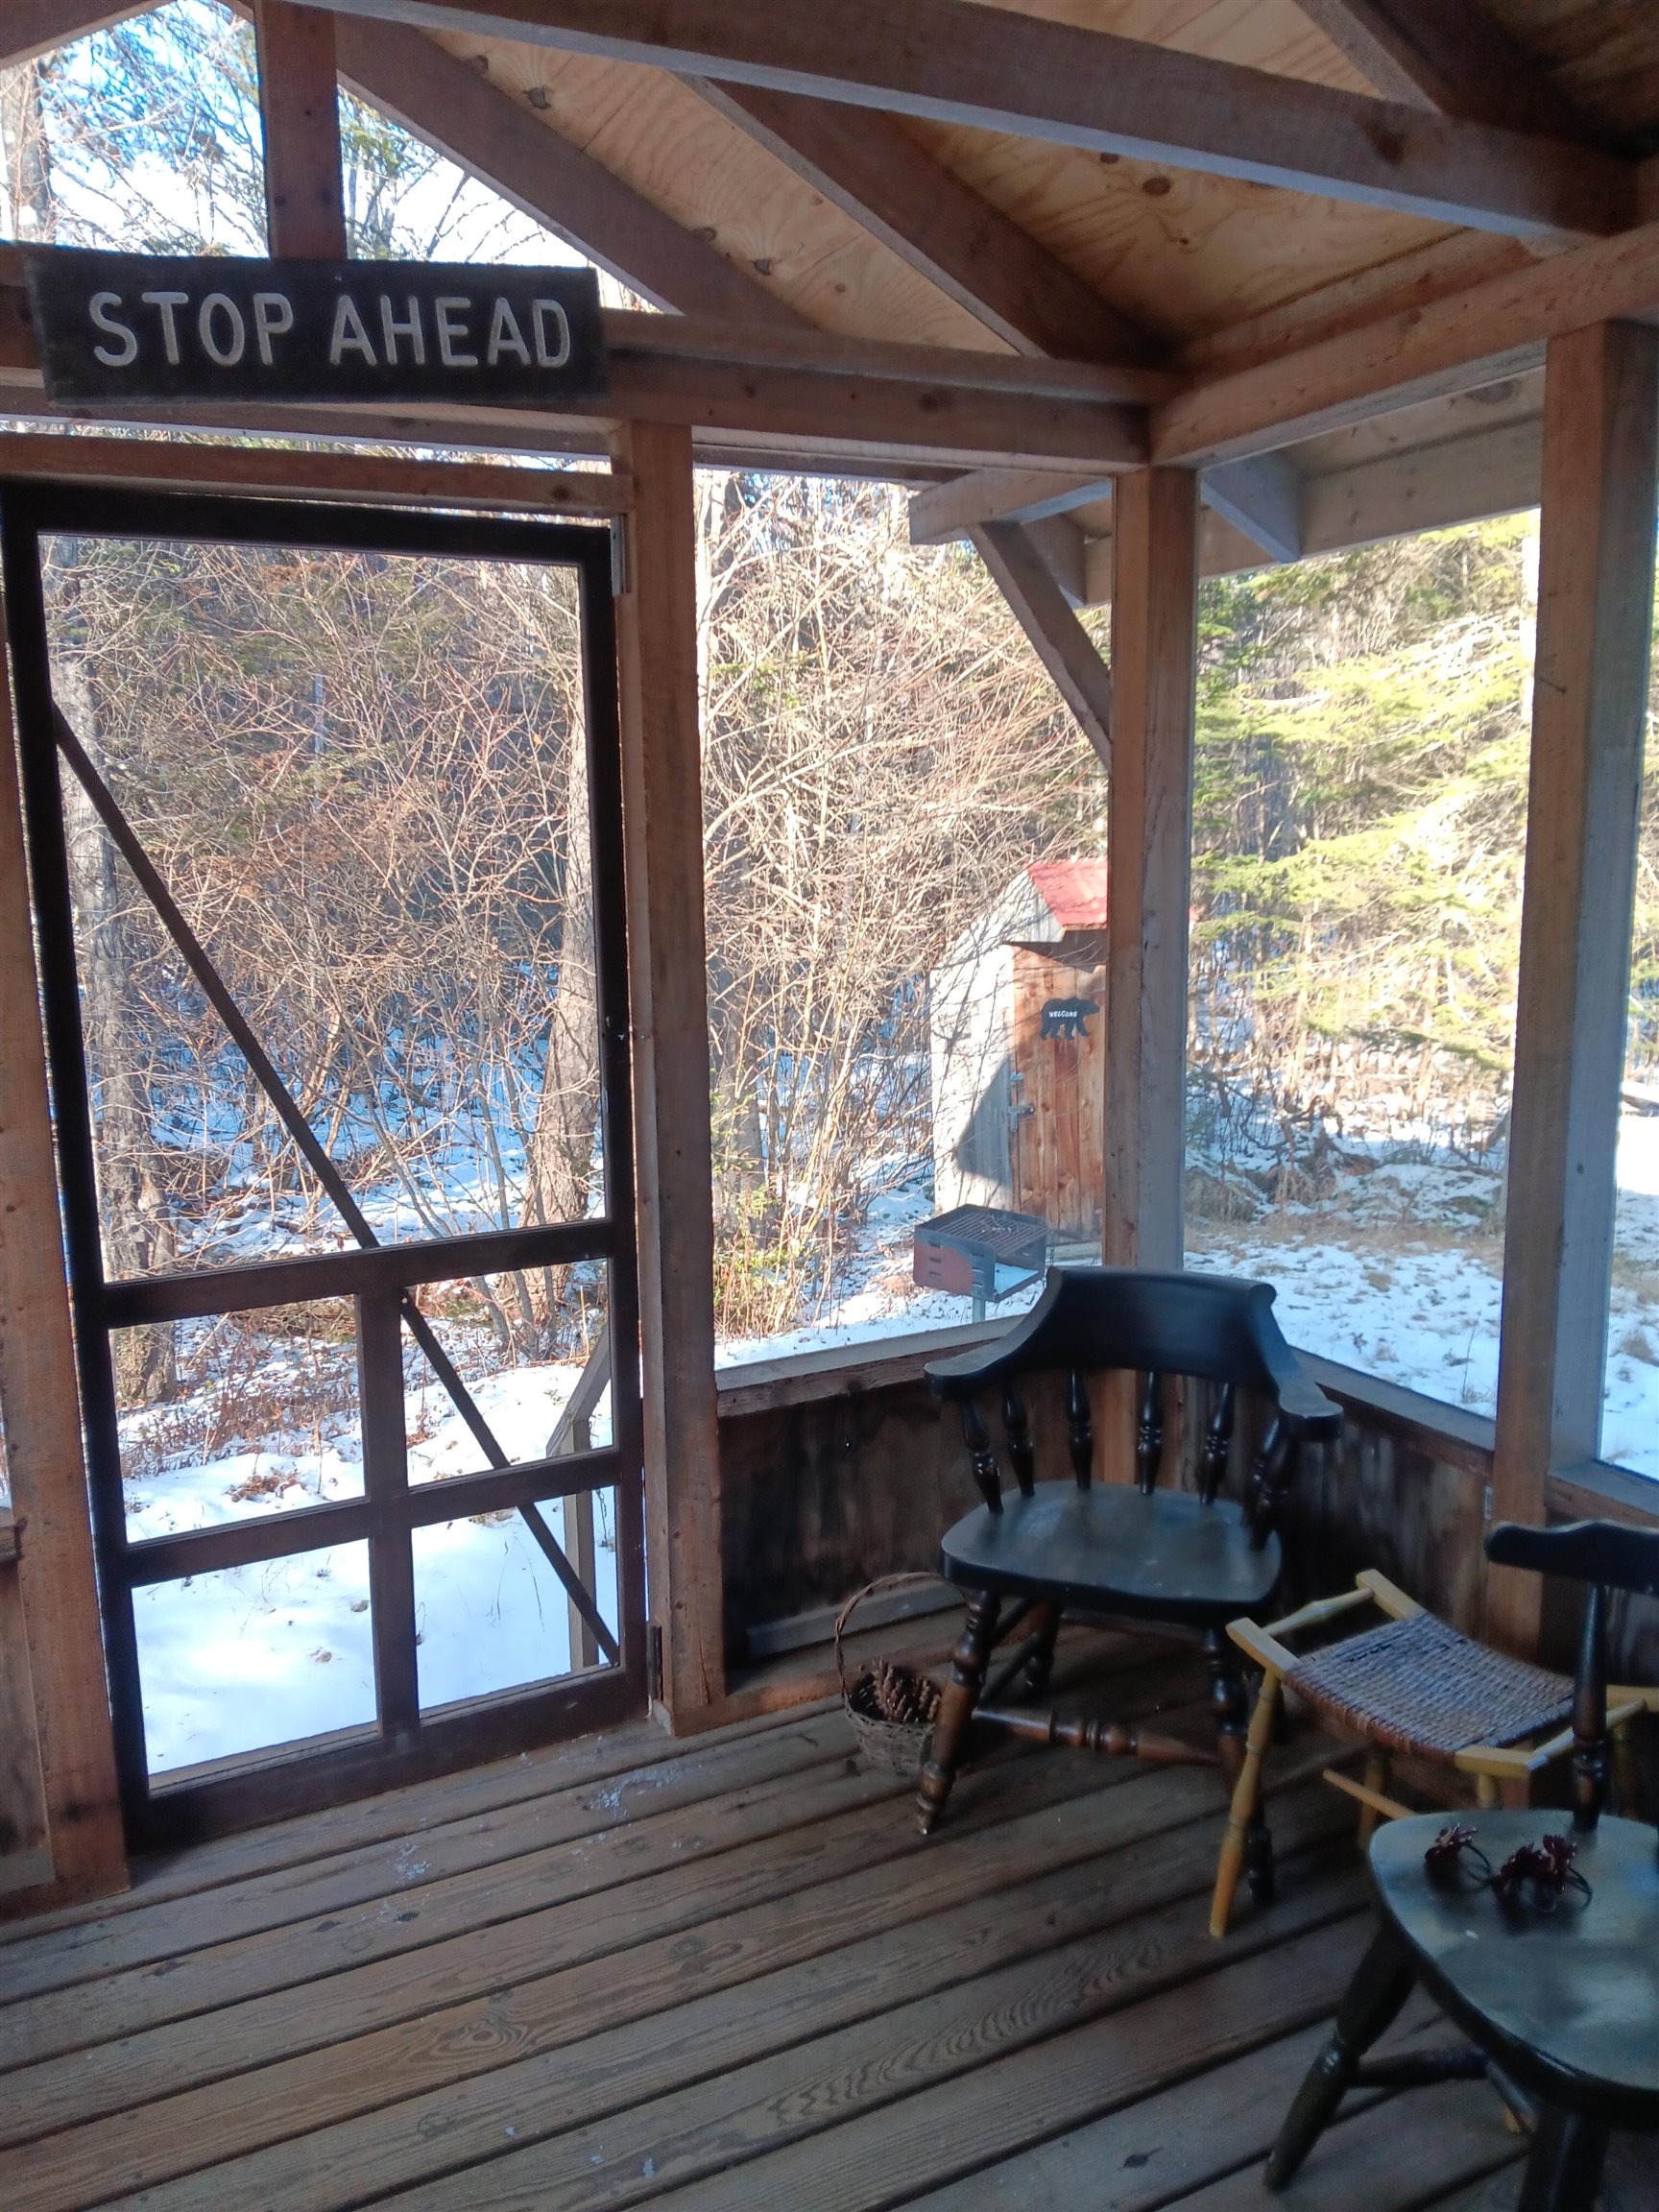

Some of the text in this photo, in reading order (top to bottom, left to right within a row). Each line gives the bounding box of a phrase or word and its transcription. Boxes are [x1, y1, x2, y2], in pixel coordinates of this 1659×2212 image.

[88, 291, 571, 369] STOP AHEAD
[1048, 1010, 1078, 1019] WELCOME
